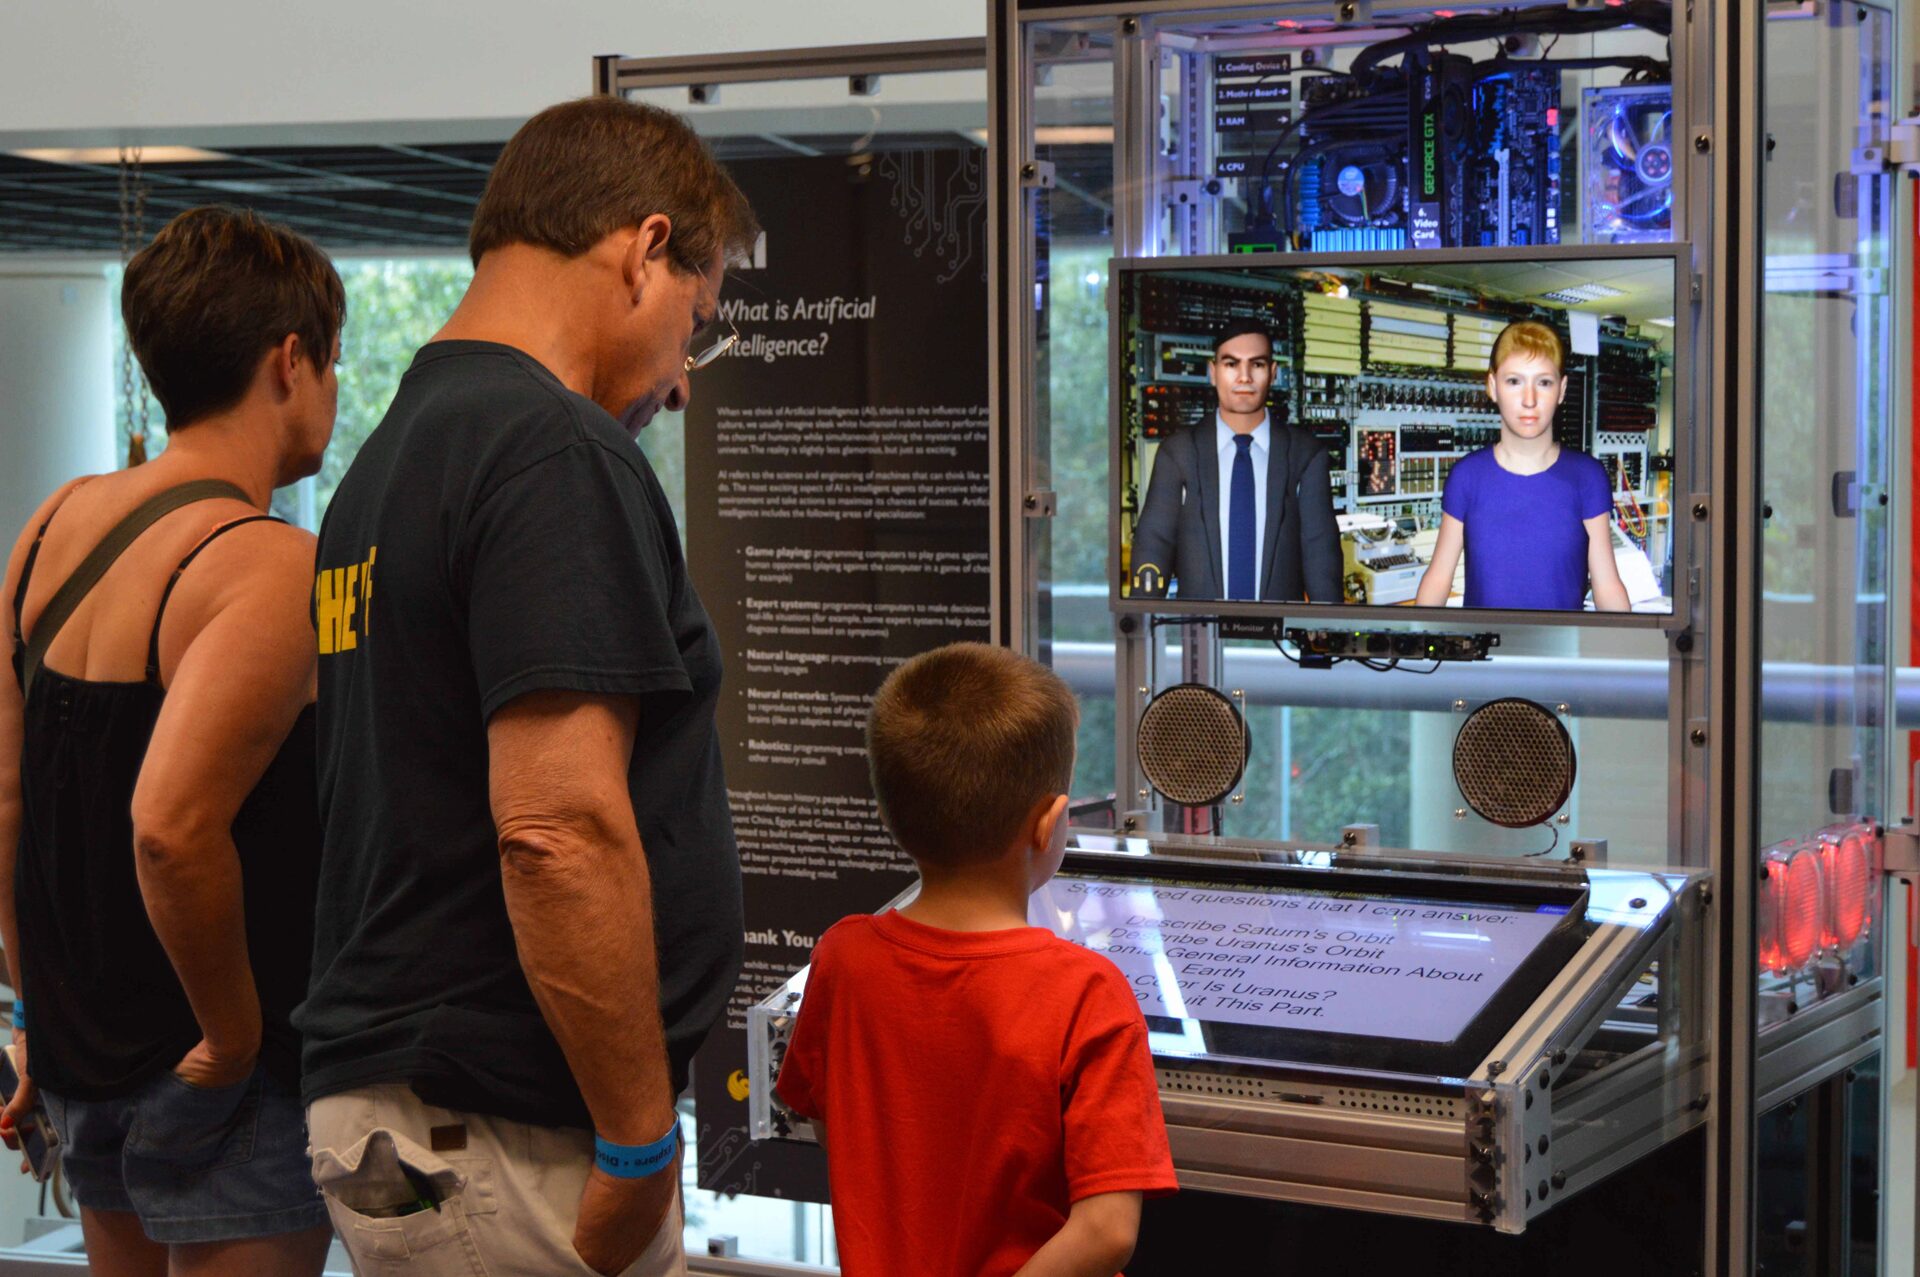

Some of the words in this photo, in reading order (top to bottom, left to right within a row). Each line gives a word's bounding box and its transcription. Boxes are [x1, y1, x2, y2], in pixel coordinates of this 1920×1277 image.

[1424, 113, 1434, 138] GTX
[1424, 140, 1435, 195] GEFORCE
[1414, 219, 1438, 228] Video
[1414, 230, 1434, 239] Card
[718, 299, 770, 322] What
[775, 300, 790, 321] is
[792, 296, 876, 325] Artificial
[746, 546, 774, 557] Game
[776, 548, 811, 559] playing:
[746, 598, 779, 610] Expert
[747, 649, 783, 660] Natural
[785, 652, 829, 664] language:
[748, 688, 780, 699] Neural
[781, 692, 828, 700] networks:
[748, 739, 791, 751] Robotics:
[1192, 893, 1298, 910] questions
[1307, 900, 1350, 913] that
[1358, 903, 1368, 913] I
[1372, 907, 1415, 918] can
[1422, 910, 1518, 924] answer:
[782, 930, 814, 948] You
[1233, 924, 1328, 940] Saturn's
[1336, 931, 1395, 945] Orbit
[1216, 936, 1318, 954] Uranus's
[1326, 945, 1386, 960] Orbit
[1166, 948, 1259, 964] General
[1265, 955, 1401, 976] Information
[1406, 967, 1484, 982] About
[1181, 964, 1246, 978] Earth
[1203, 980, 1224, 992] Is
[1233, 984, 1337, 1002] Uranus?
[1216, 997, 1263, 1011] This
[1270, 1003, 1325, 1017] Part.
